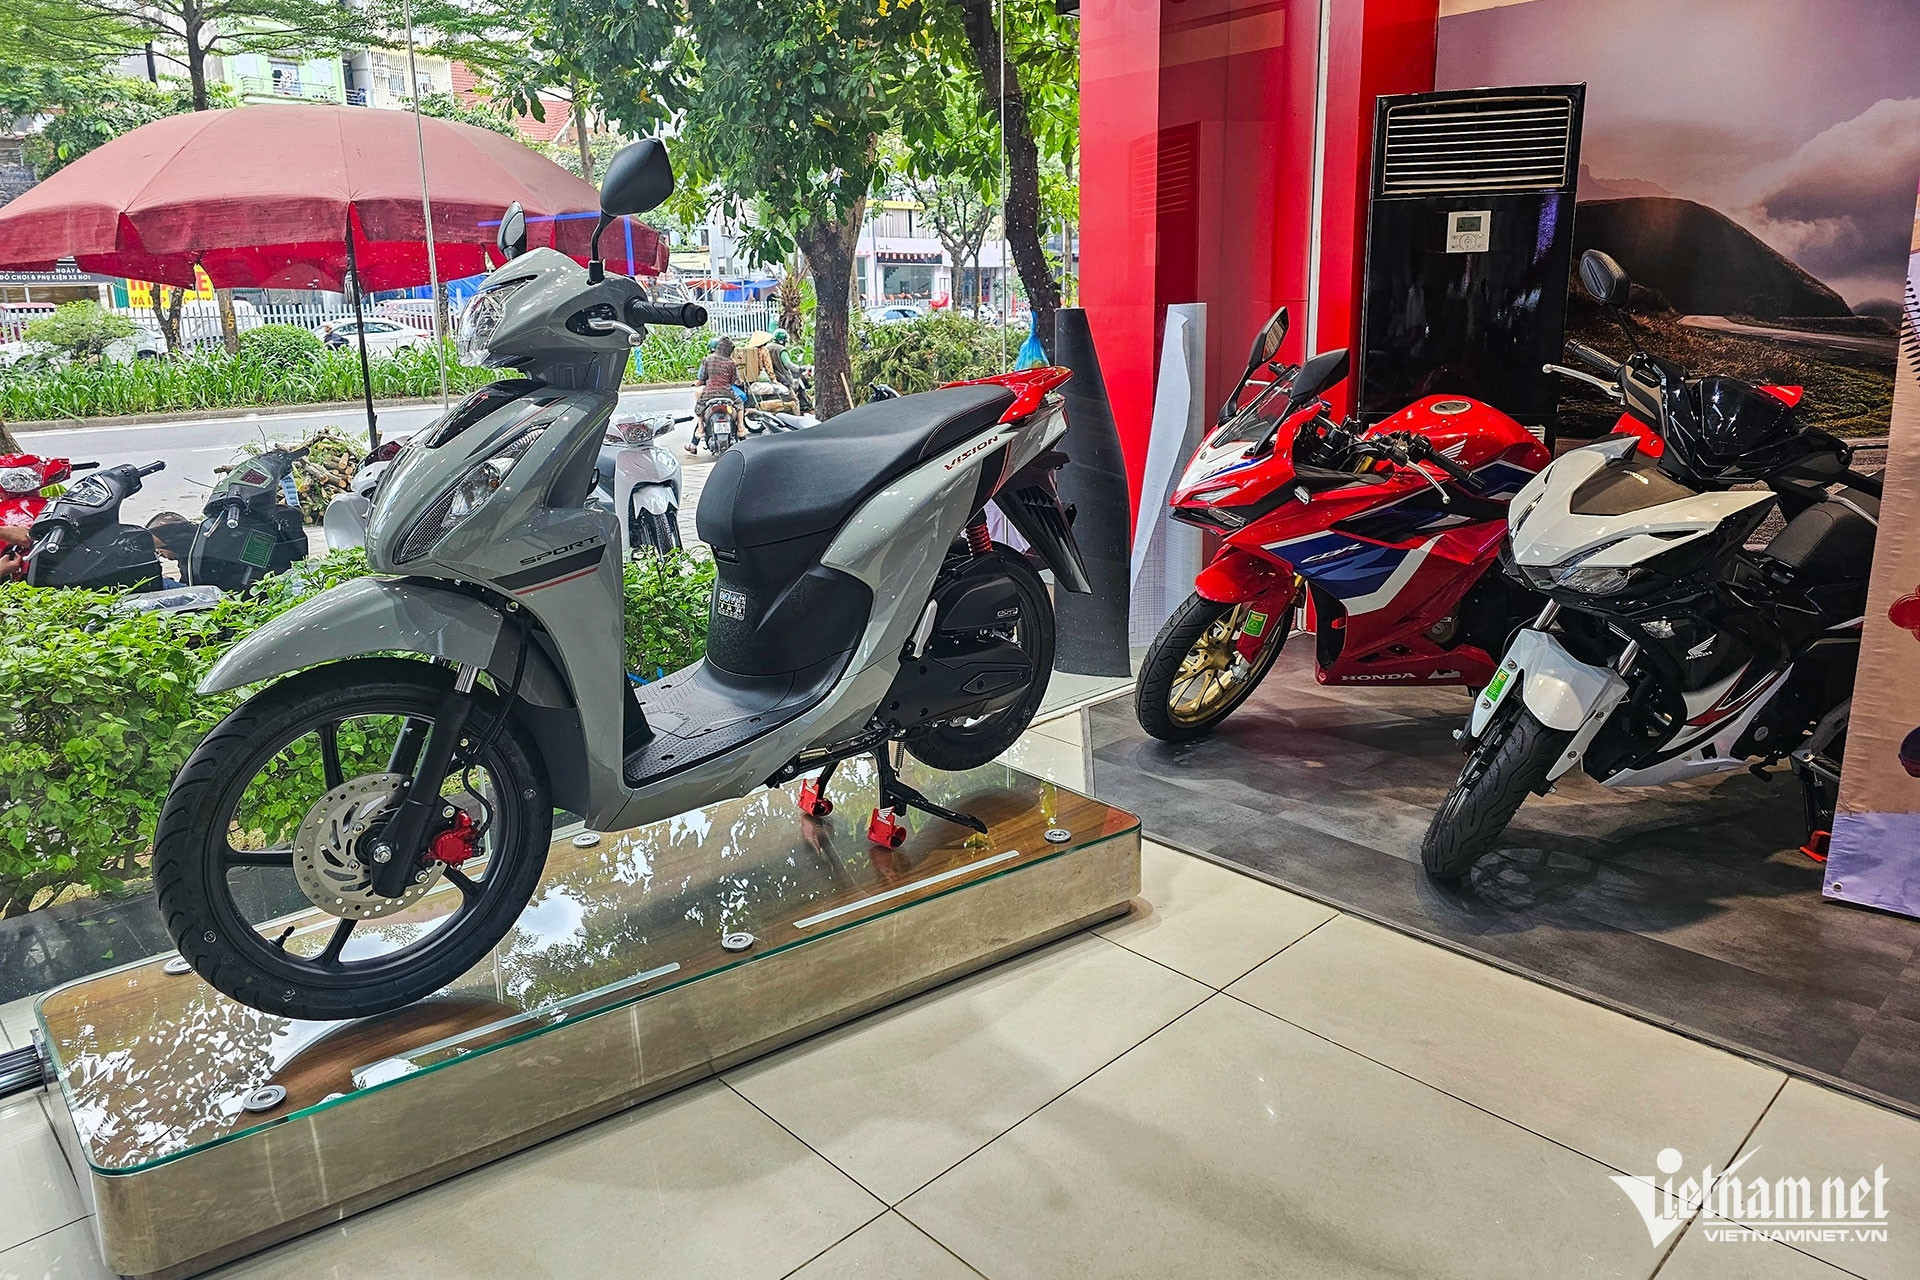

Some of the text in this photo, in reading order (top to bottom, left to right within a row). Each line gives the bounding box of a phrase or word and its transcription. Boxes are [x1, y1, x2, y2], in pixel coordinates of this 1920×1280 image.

[944, 435, 999, 470] VISION
[520, 534, 599, 566] SPORT
[1341, 673, 1417, 681] HONDA
